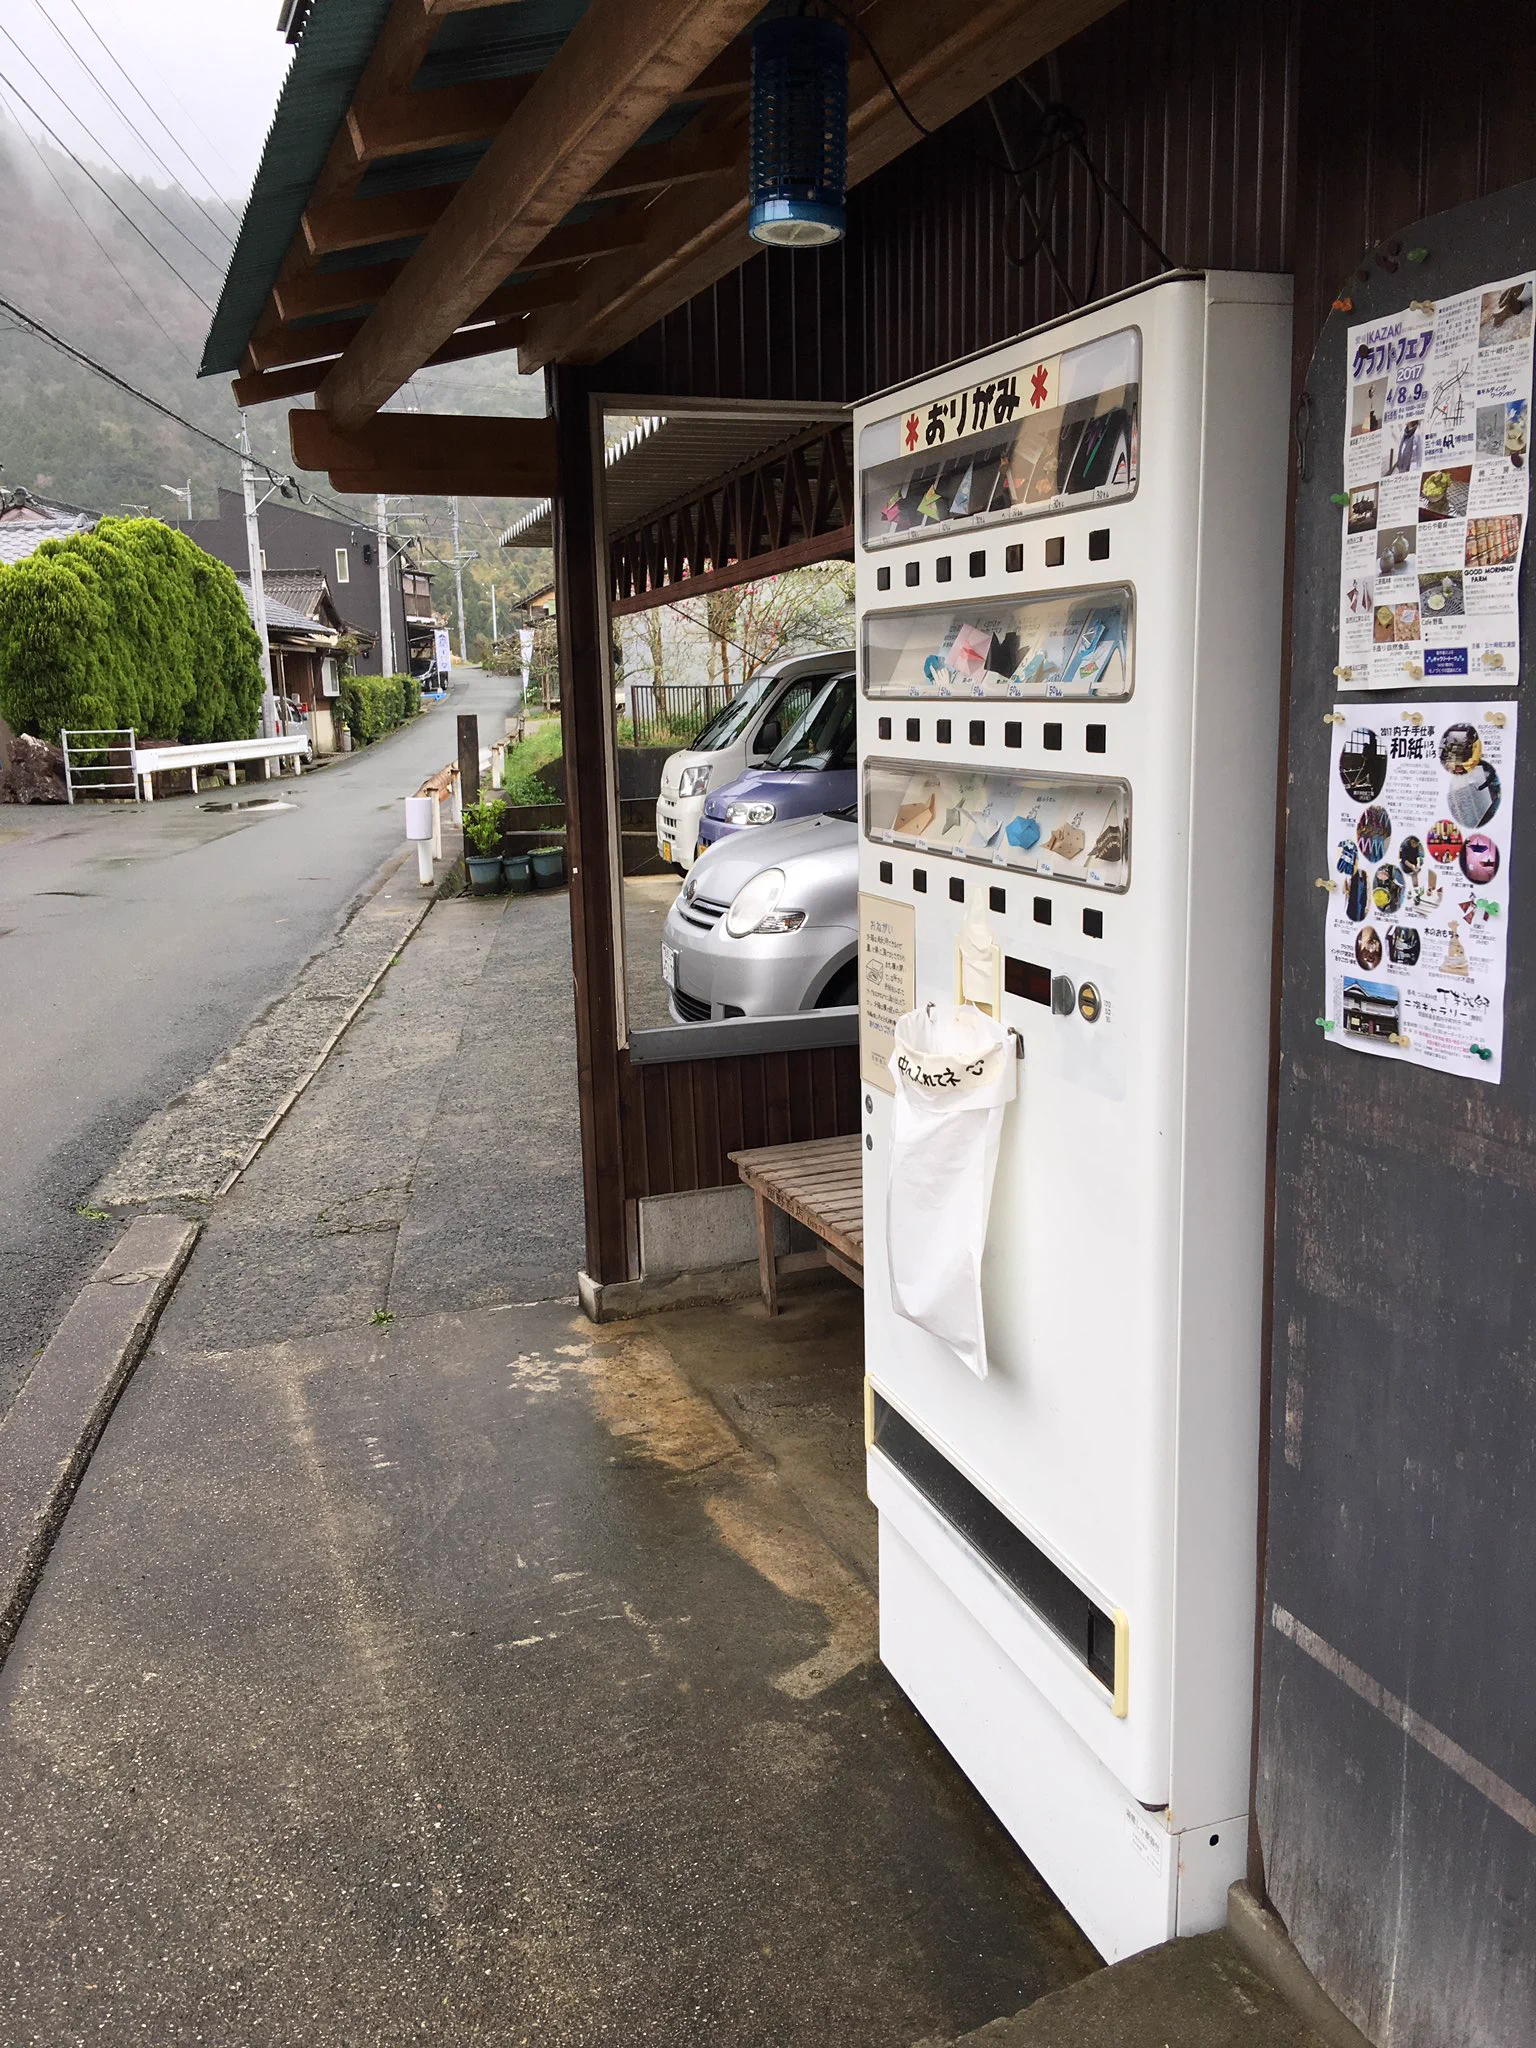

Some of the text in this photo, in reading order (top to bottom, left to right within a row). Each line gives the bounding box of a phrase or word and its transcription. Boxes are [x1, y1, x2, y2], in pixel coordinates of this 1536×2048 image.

[1396, 364, 1424, 382] 2017
[925, 376, 1020, 446] おりがみ
[1464, 566, 1515, 577] GOOD MORNING
[1471, 576, 1488, 584] FARM
[1390, 737, 1423, 760] 和紙
[1424, 927, 1460, 940] 木のおもちゃ
